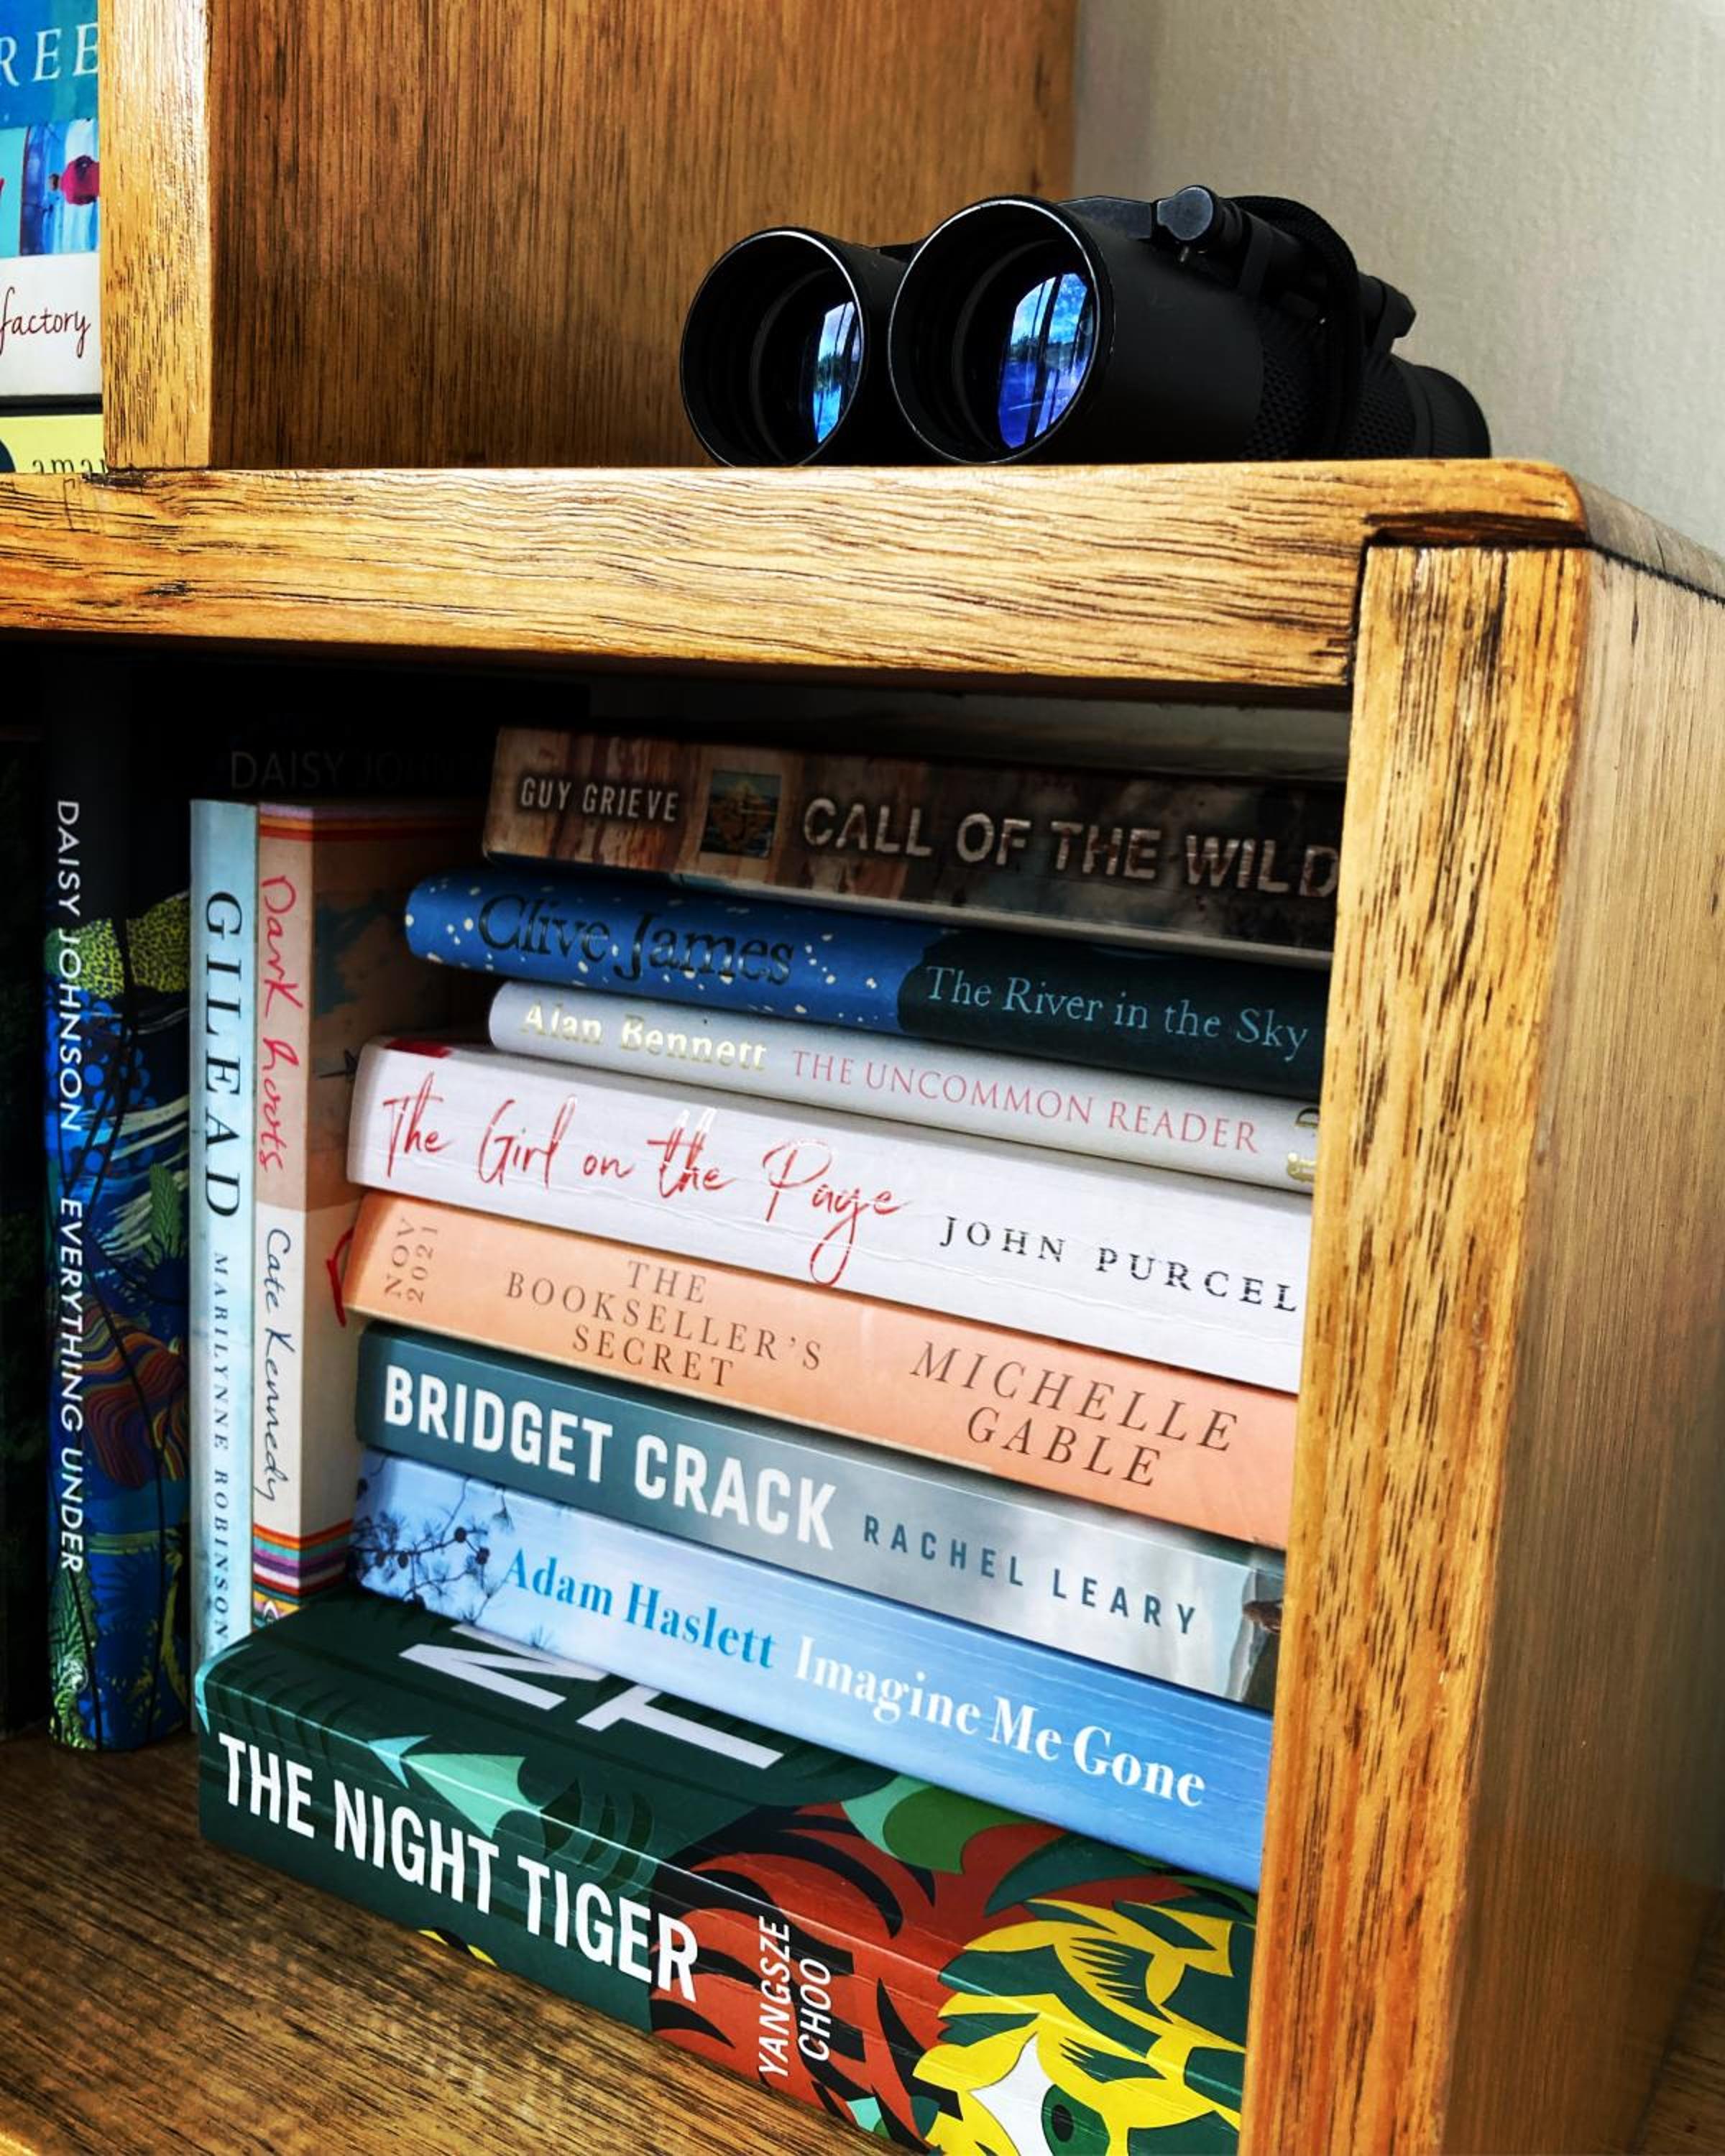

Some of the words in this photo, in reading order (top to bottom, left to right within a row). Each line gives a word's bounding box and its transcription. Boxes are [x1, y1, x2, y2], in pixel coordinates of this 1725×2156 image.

[0, 286, 91, 358] factory
[230, 750, 345, 791] DAISY
[521, 776, 572, 811] GUY
[582, 783, 679, 822] GRIEVE
[58, 801, 81, 918] DAISY
[803, 797, 933, 857] CALL
[956, 812, 1031, 866] OF
[1051, 820, 1161, 880] THE
[1186, 834, 1340, 898] WILD
[259, 875, 305, 1015] Dark
[479, 892, 610, 962] Clive
[613, 909, 796, 986] James
[58, 929, 83, 1133] JOHNSON
[204, 890, 243, 1217] GILEAD
[521, 1000, 604, 1046] Alan
[620, 1013, 767, 1072] Bennett
[927, 966, 990, 1008] The
[1002, 977, 1103, 1023] River
[1115, 992, 1149, 1029] in
[1164, 1000, 1222, 1038] the
[1236, 1009, 1310, 1062] Sky
[792, 1051, 853, 1085] THE
[866, 1062, 1094, 1125] UNCOMMON
[1108, 1101, 1259, 1154] READER
[382, 1071, 458, 1179] The
[479, 1095, 578, 1189] Girl
[583, 1153, 638, 1180] on
[646, 1107, 740, 1200] the
[762, 1138, 907, 1286] Page
[263, 1227, 292, 1315] Cate
[385, 1218, 415, 1300] NOV
[407, 1225, 438, 1304] 2021
[627, 1261, 707, 1304] THE
[939, 1216, 1065, 1263] JOHN
[1095, 1247, 1297, 1312] PURCEL
[60, 1197, 84, 1434] EVERYTHING
[212, 1253, 229, 1450] MARILYNNE
[573, 1325, 734, 1388] SECRET
[254, 1328, 298, 1503] Kennedy
[910, 1341, 1238, 1452] MICHELLE
[967, 1406, 1162, 1486] GABLE
[60, 1444, 85, 1573] UNDER
[385, 1365, 614, 1483] BRIDGET
[634, 1434, 839, 1551] CRACK
[213, 1470, 229, 1639] ROBINSON
[503, 1547, 613, 1617] Adam
[624, 1583, 777, 1669] Haslett
[864, 1514, 1024, 1587] RACHEL
[1052, 1568, 1196, 1635] LEARY
[794, 1634, 982, 1736] Imagine
[988, 1696, 1064, 1761] Me
[1072, 1725, 1206, 1807] Gone
[218, 1732, 315, 1839] THE
[334, 1779, 500, 1915] NIGHT
[517, 1854, 699, 2003] TIGER
[758, 1916, 790, 2076] YANGSZE
[797, 1959, 832, 2063] CHOO
